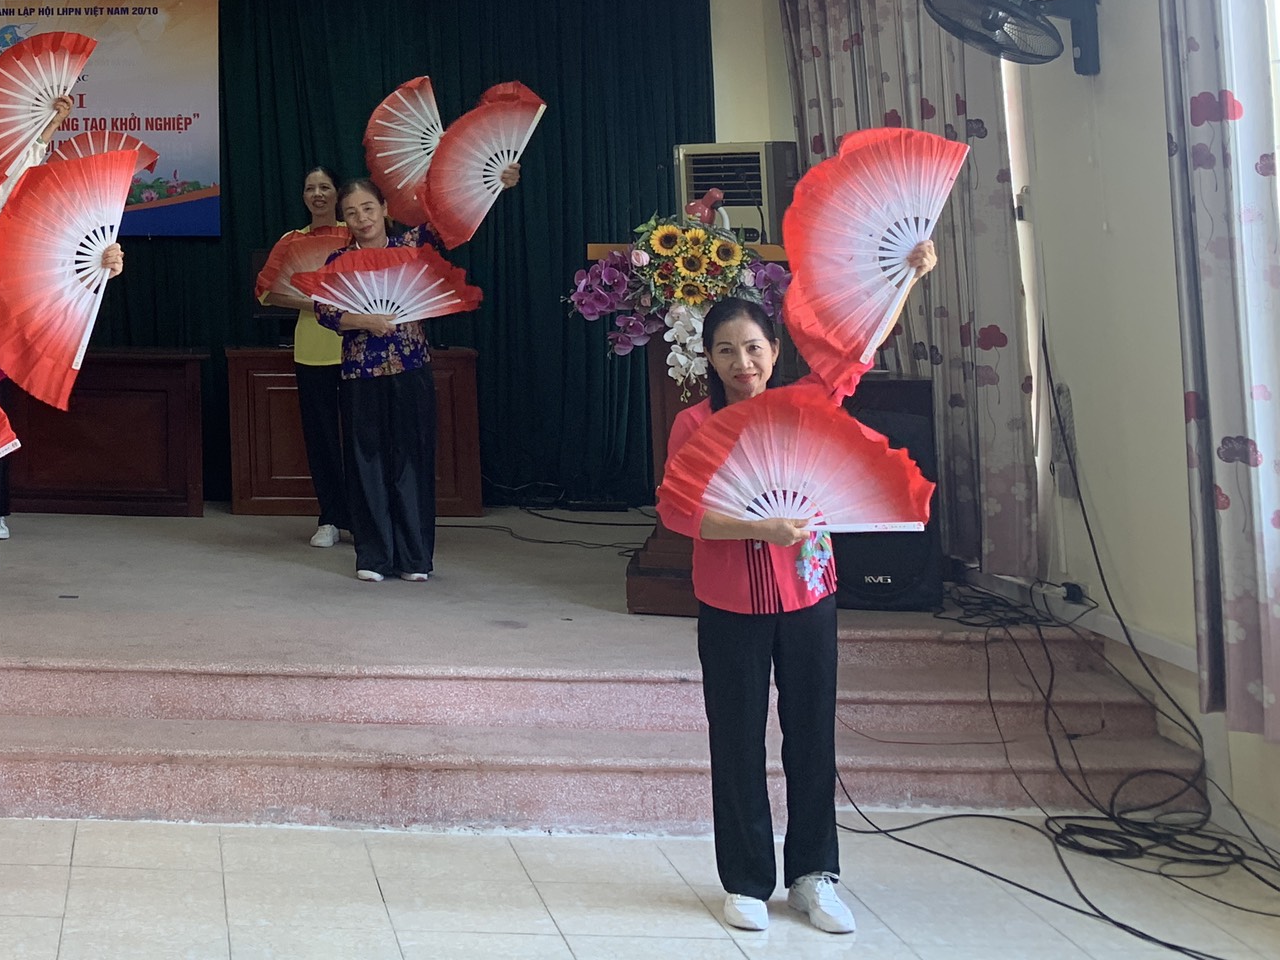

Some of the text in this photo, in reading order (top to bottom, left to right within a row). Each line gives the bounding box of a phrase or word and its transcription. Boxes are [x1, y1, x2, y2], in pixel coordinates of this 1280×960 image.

[17, 6, 36, 17] LẬP
[38, 6, 54, 17] HỘI
[56, 7, 81, 16] LHPN
[84, 6, 104, 17] VIỆT
[107, 7, 129, 16] NAM
[132, 6, 158, 16] 20/10
[111, 113, 141, 132] KHỞI
